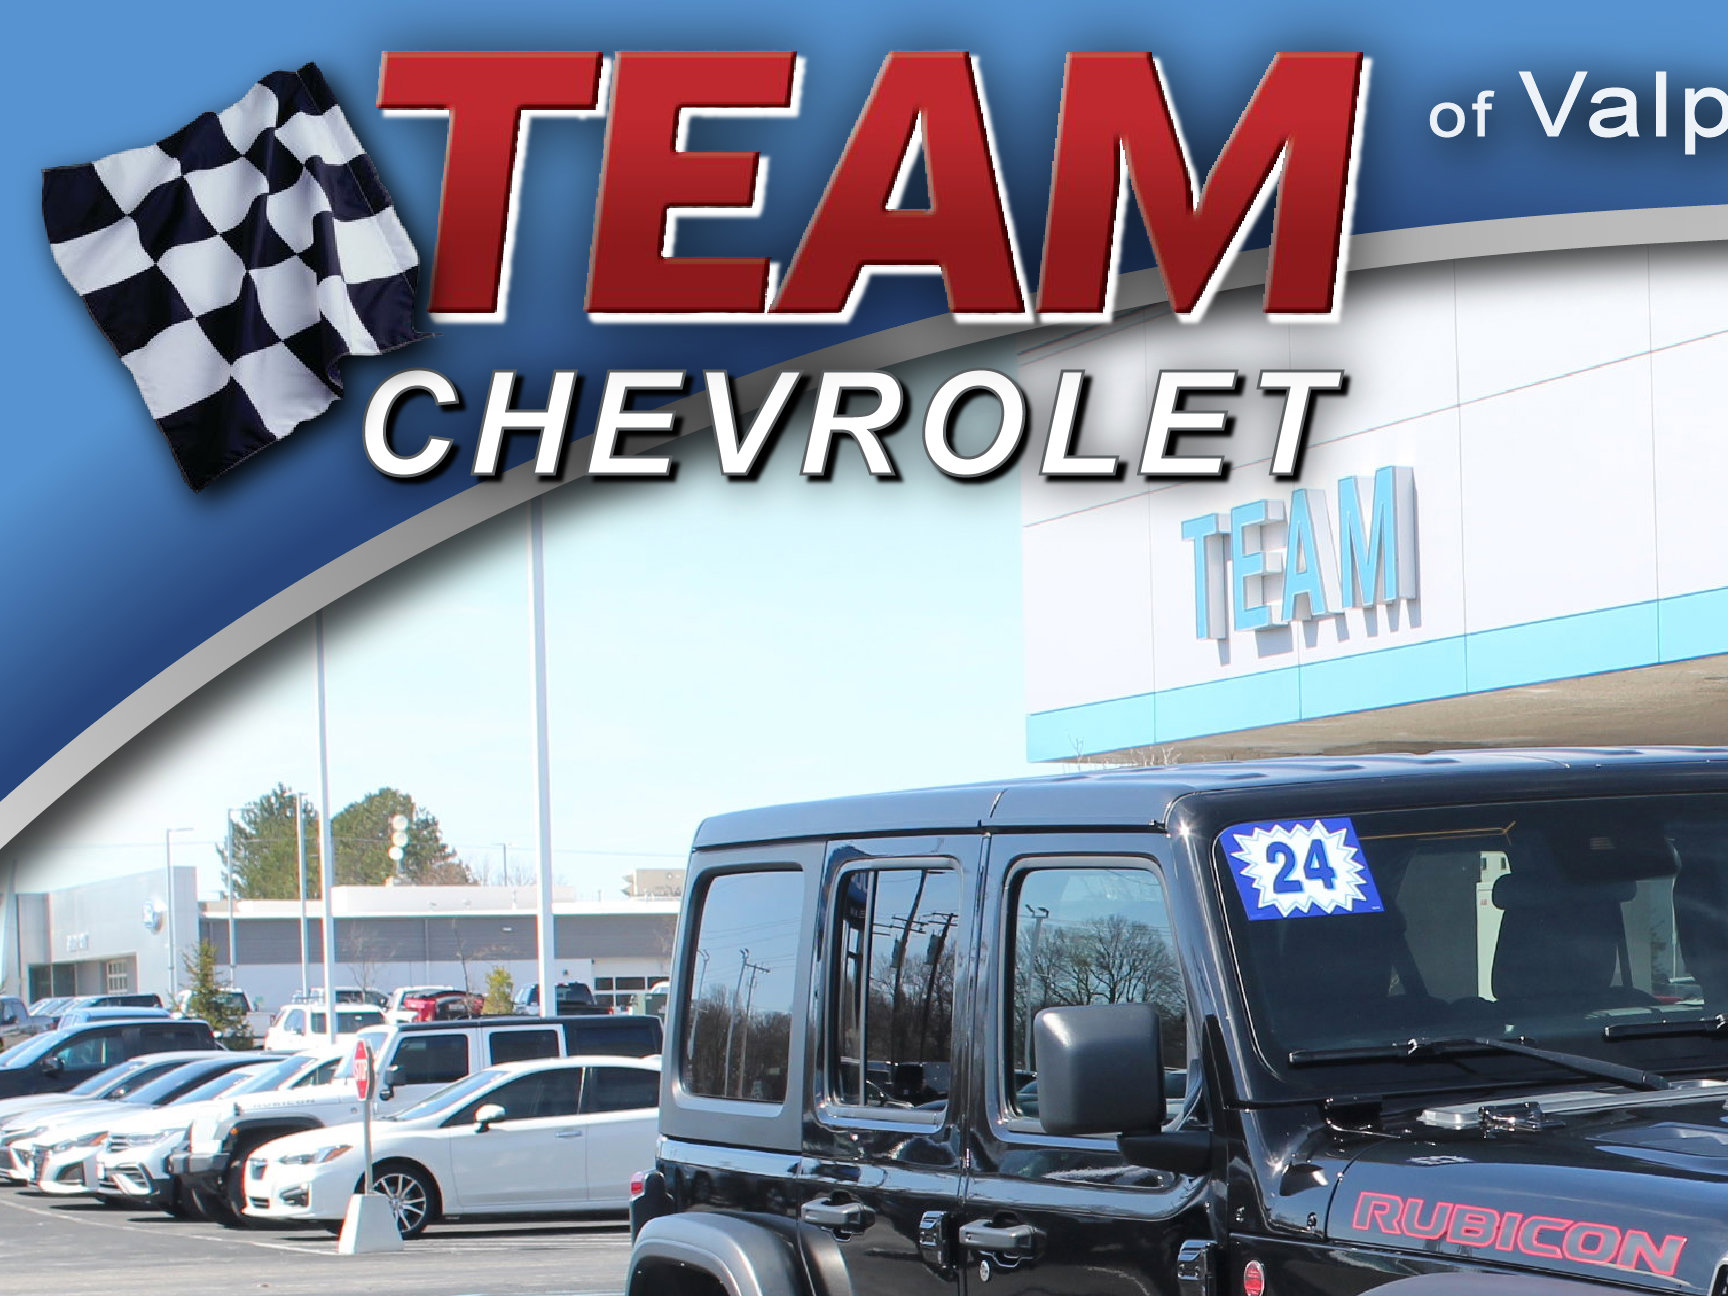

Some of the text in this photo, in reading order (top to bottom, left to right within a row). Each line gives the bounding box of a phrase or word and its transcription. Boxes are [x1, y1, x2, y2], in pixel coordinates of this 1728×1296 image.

[1181, 465, 1418, 640] TEAM
[1266, 839, 1336, 894] 24
[1352, 1191, 1688, 1276] RUBICON
